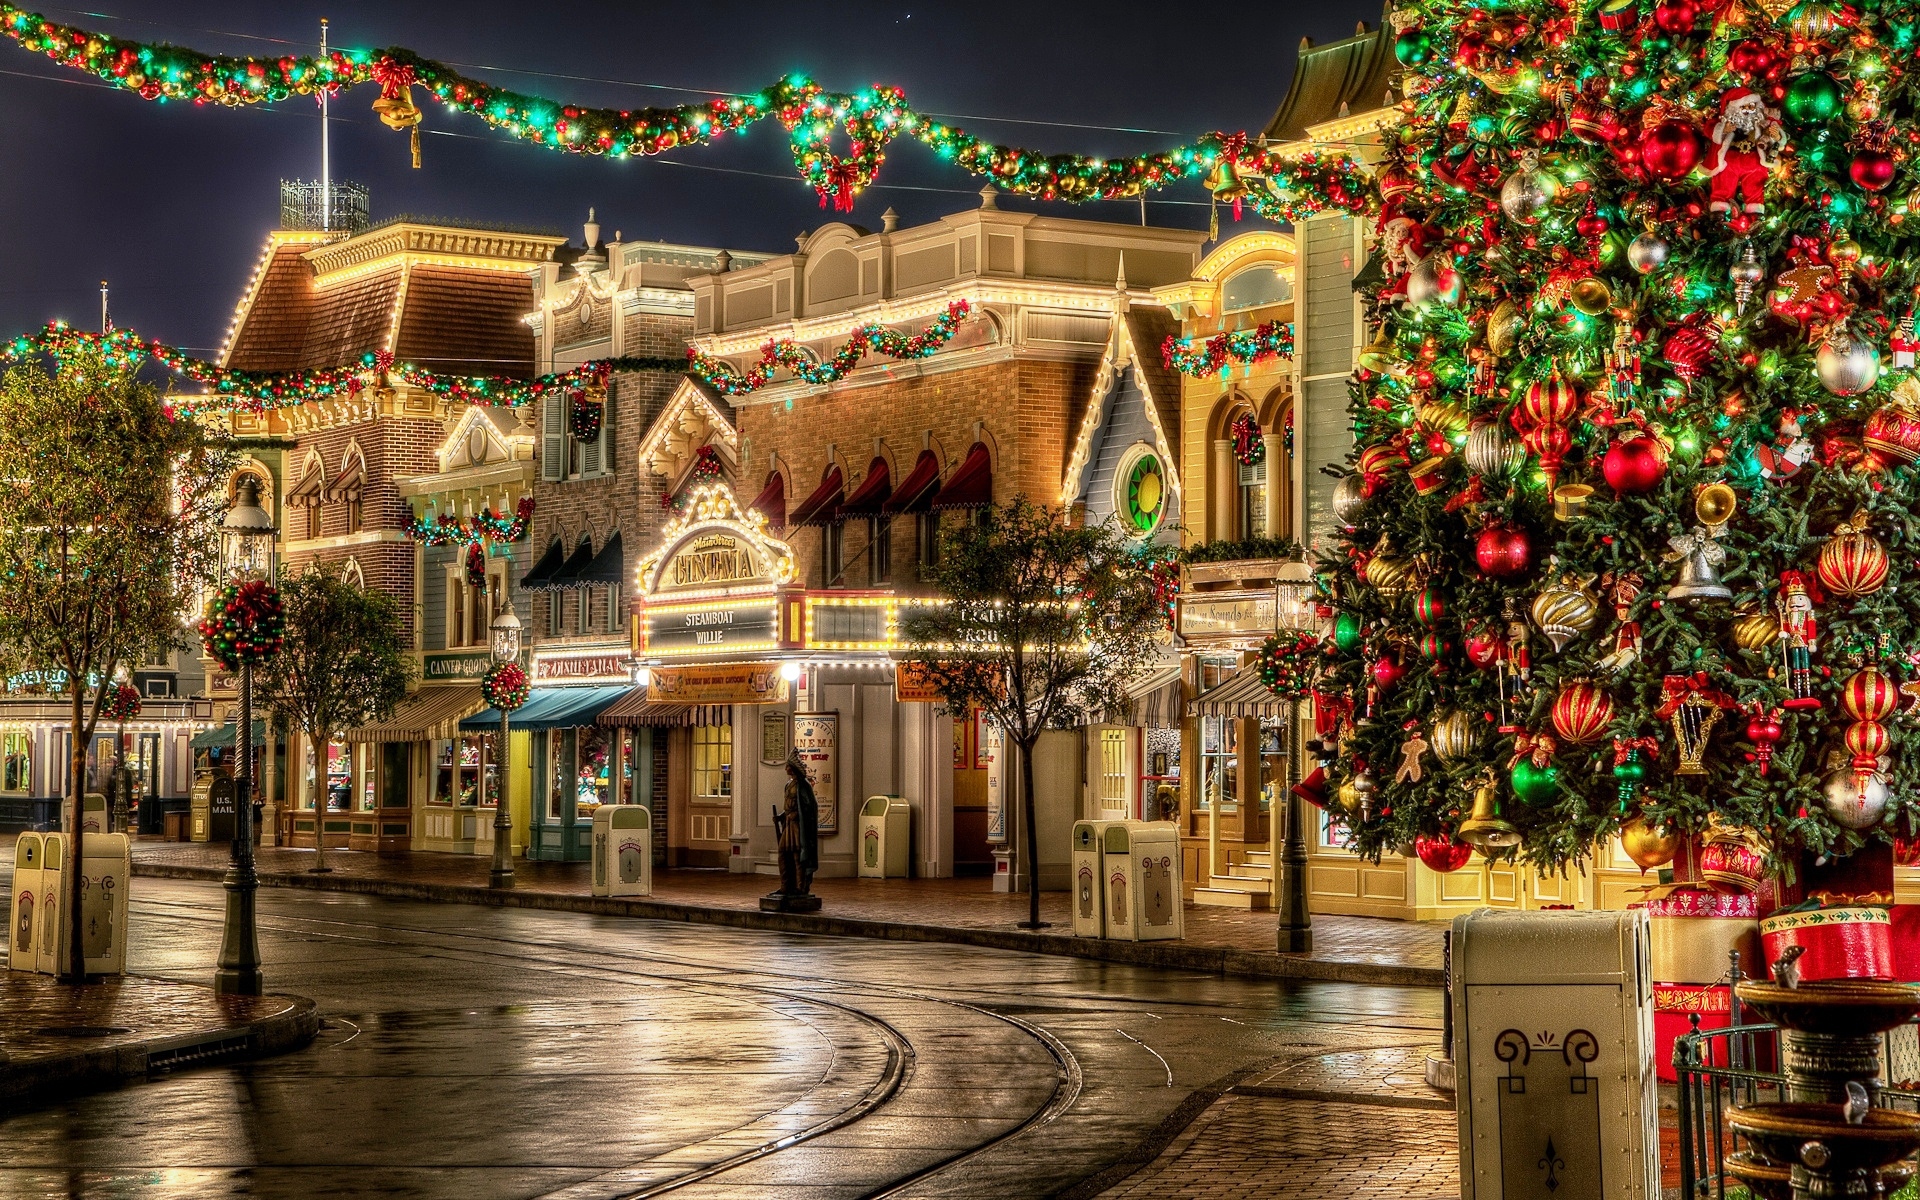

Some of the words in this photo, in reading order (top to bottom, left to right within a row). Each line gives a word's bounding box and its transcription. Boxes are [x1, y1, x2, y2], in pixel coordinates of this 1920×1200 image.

[693, 536, 713, 551] Main
[713, 534, 735, 547] Street
[674, 548, 754, 585] CINEMA
[685, 611, 734, 626] STEAMBOAT
[696, 631, 723, 645] WILLIE
[430, 660, 461, 675] CANNED
[794, 739, 834, 747] INEMA
[212, 806, 235, 814] MAIL
